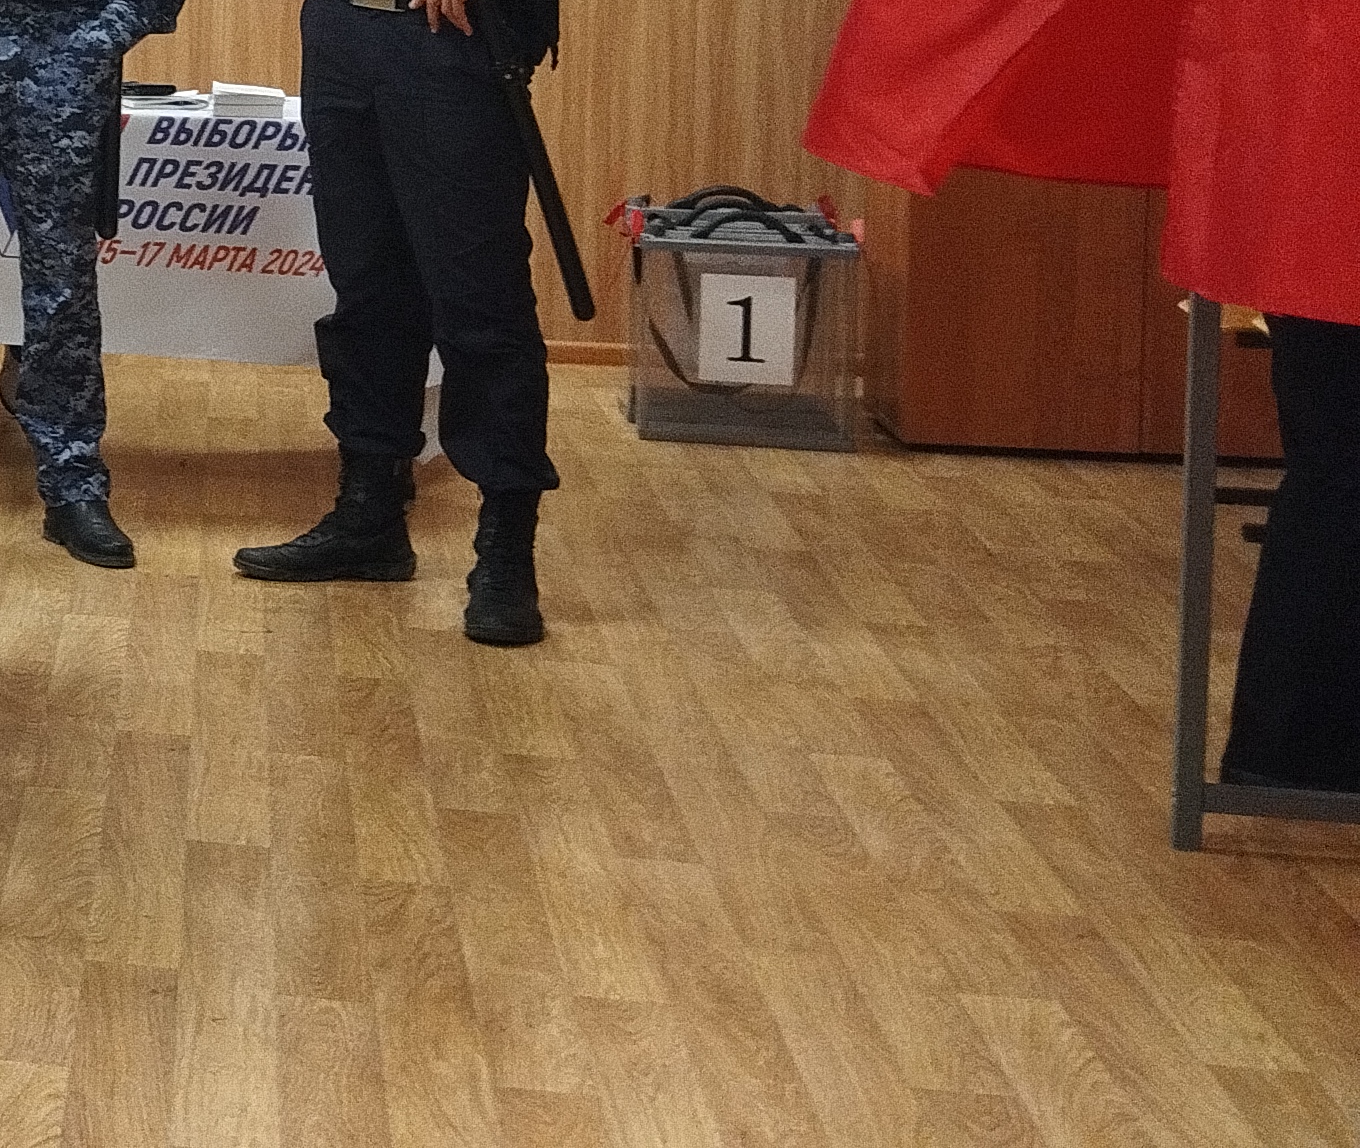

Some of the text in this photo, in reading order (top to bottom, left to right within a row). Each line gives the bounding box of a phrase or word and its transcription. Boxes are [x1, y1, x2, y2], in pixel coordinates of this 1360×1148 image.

[146, 115, 311, 151] ВЫБОРЫ
[126, 156, 313, 198] ПРЕЗИДЕН
[165, 242, 258, 272] МАРТА
[260, 247, 324, 277] 2024
[726, 295, 766, 364] 1
